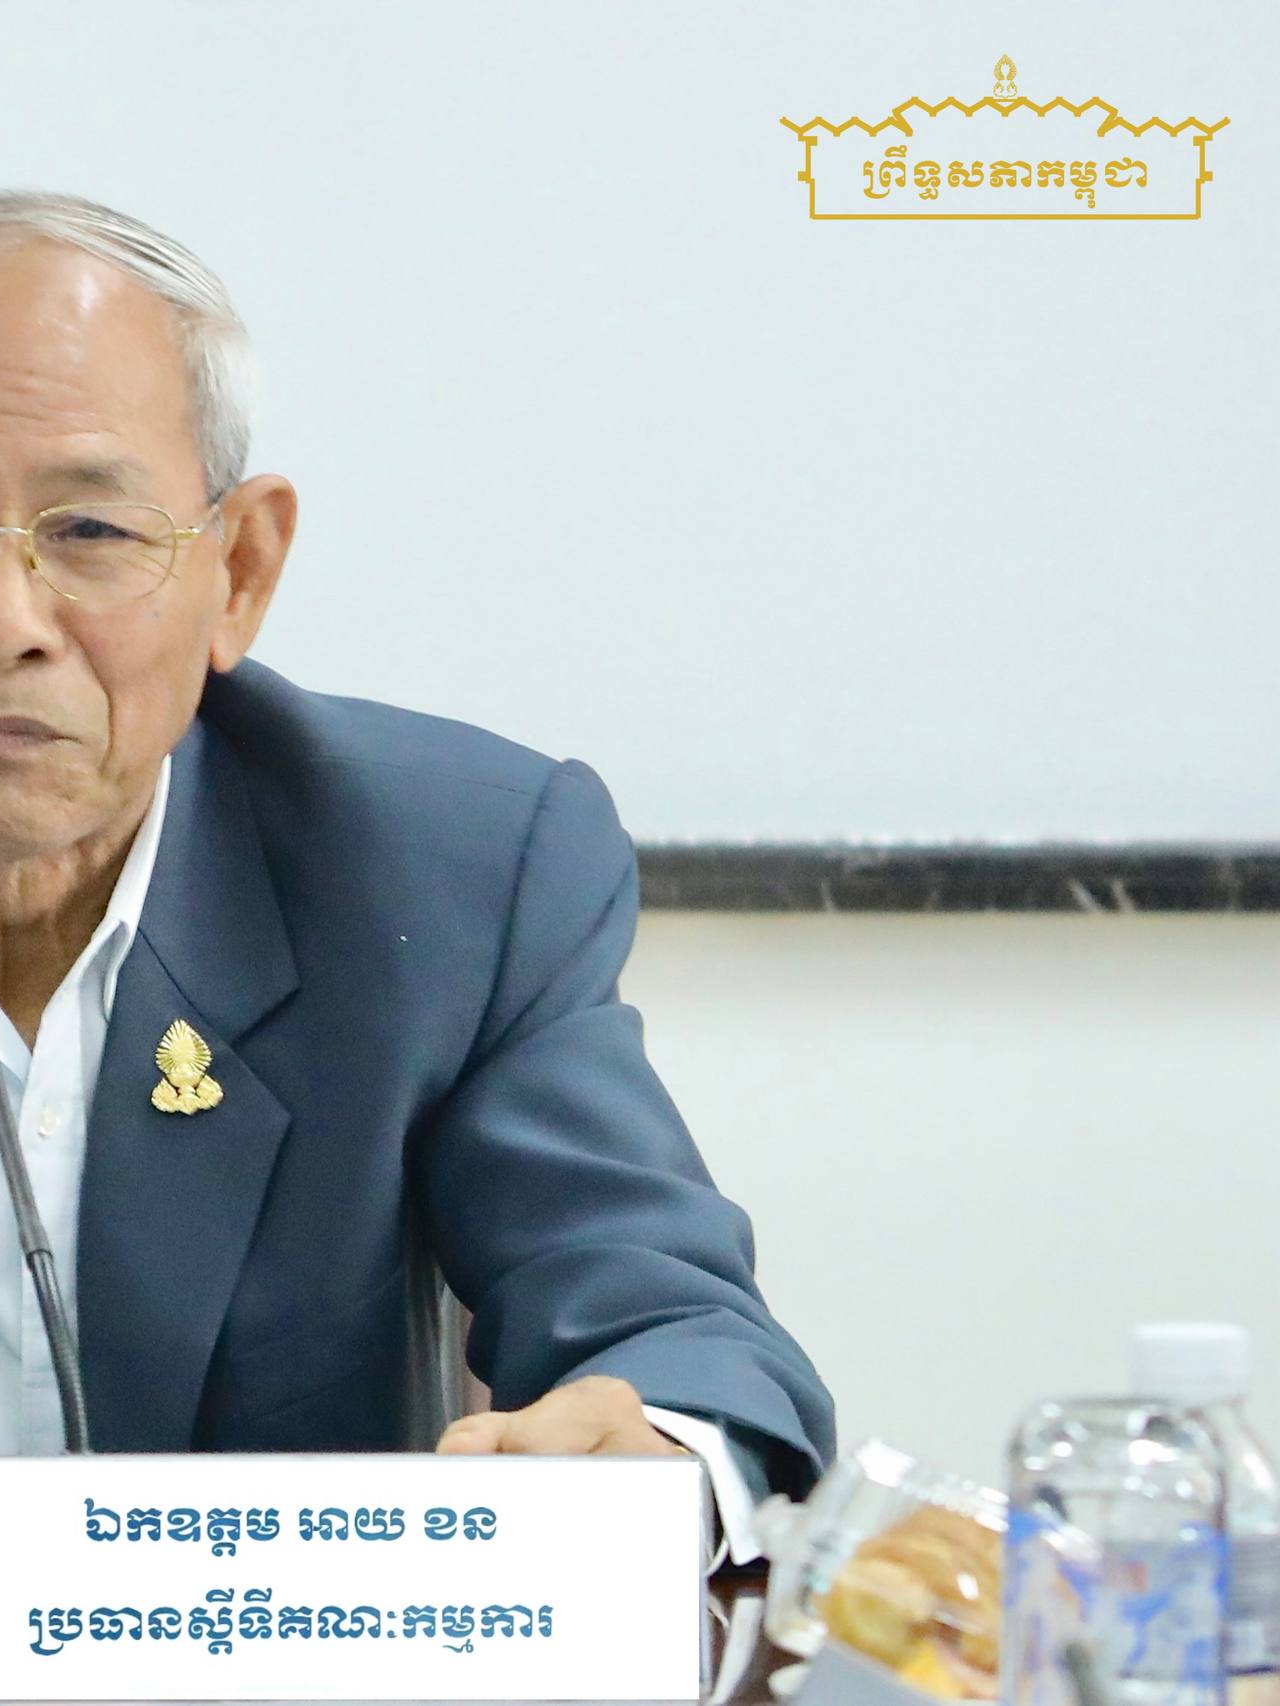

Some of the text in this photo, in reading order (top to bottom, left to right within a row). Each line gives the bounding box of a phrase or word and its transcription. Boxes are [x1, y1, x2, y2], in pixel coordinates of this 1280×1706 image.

[83, 1497, 497, 1558] ឯកឧត្តម អាយ ខន
